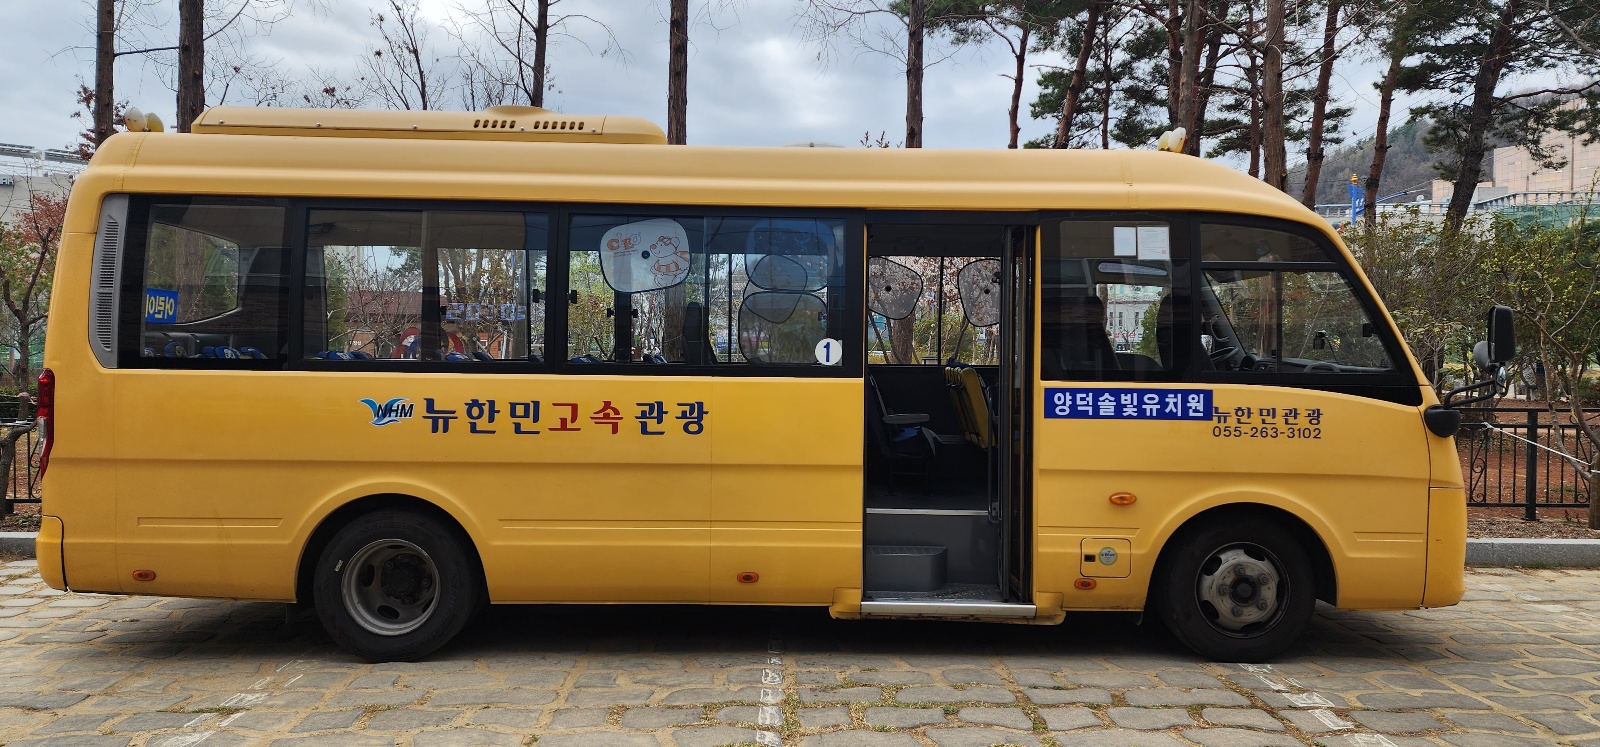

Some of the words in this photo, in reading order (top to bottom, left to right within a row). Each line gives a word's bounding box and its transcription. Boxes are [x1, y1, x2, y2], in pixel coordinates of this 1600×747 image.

[823, 341, 831, 363] 1
[376, 402, 414, 418] NHM
[1053, 392, 1205, 417] 양덕솔빛유치원
[1212, 406, 1323, 425] 뉴한민관광
[1212, 426, 1322, 439] 055-263-3102
